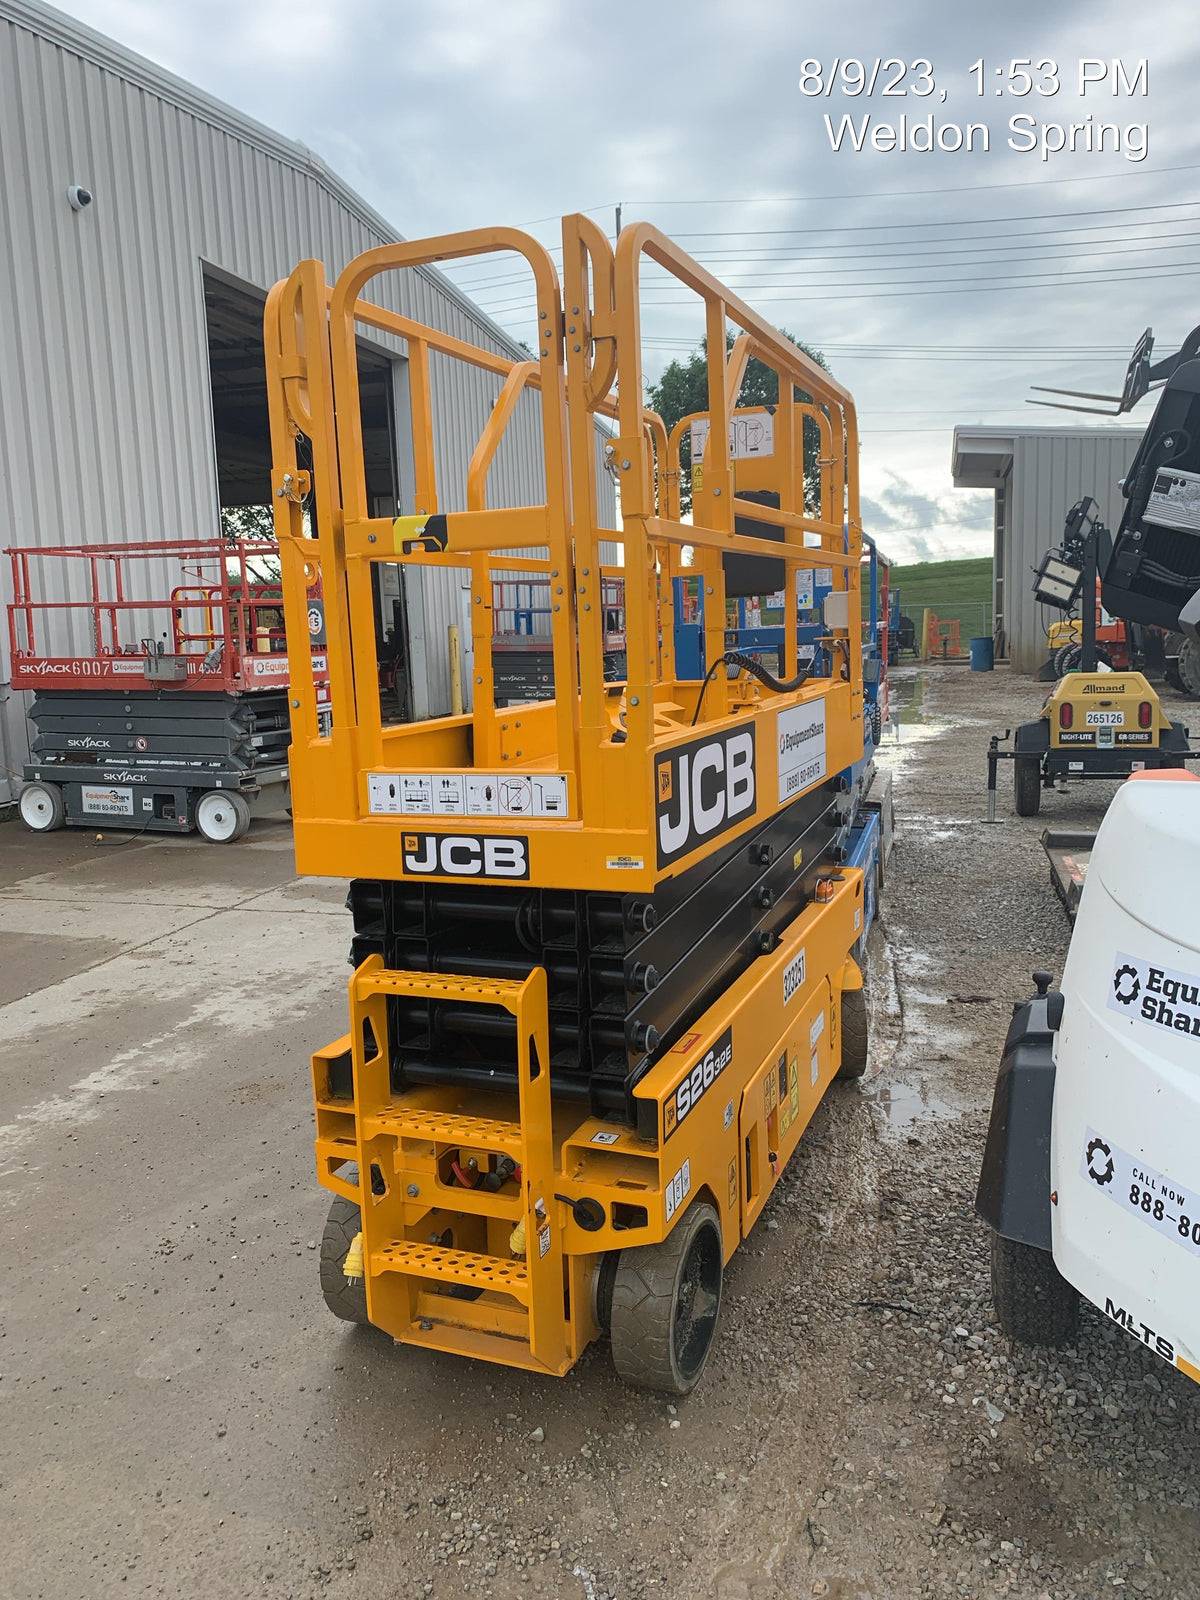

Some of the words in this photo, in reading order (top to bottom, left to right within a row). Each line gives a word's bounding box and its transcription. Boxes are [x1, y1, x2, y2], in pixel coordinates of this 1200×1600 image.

[19, 661, 70, 675] SKYJACK
[73, 661, 110, 676] 6007
[1082, 684, 1125, 694] Allmand
[1087, 714, 1123, 724] 265126
[67, 736, 111, 748] SKYJACK
[785, 723, 825, 752] EquipmentShare
[103, 771, 148, 782] SKYJACK
[659, 732, 755, 854] JCB
[405, 836, 526, 877] JCB
[783, 955, 805, 1002] 323251
[1146, 967, 1200, 1006] Equ
[677, 1050, 714, 1121] S26
[714, 1043, 732, 1076] 32E
[1132, 1167, 1156, 1190] CALL
[1160, 1185, 1185, 1206] NOW
